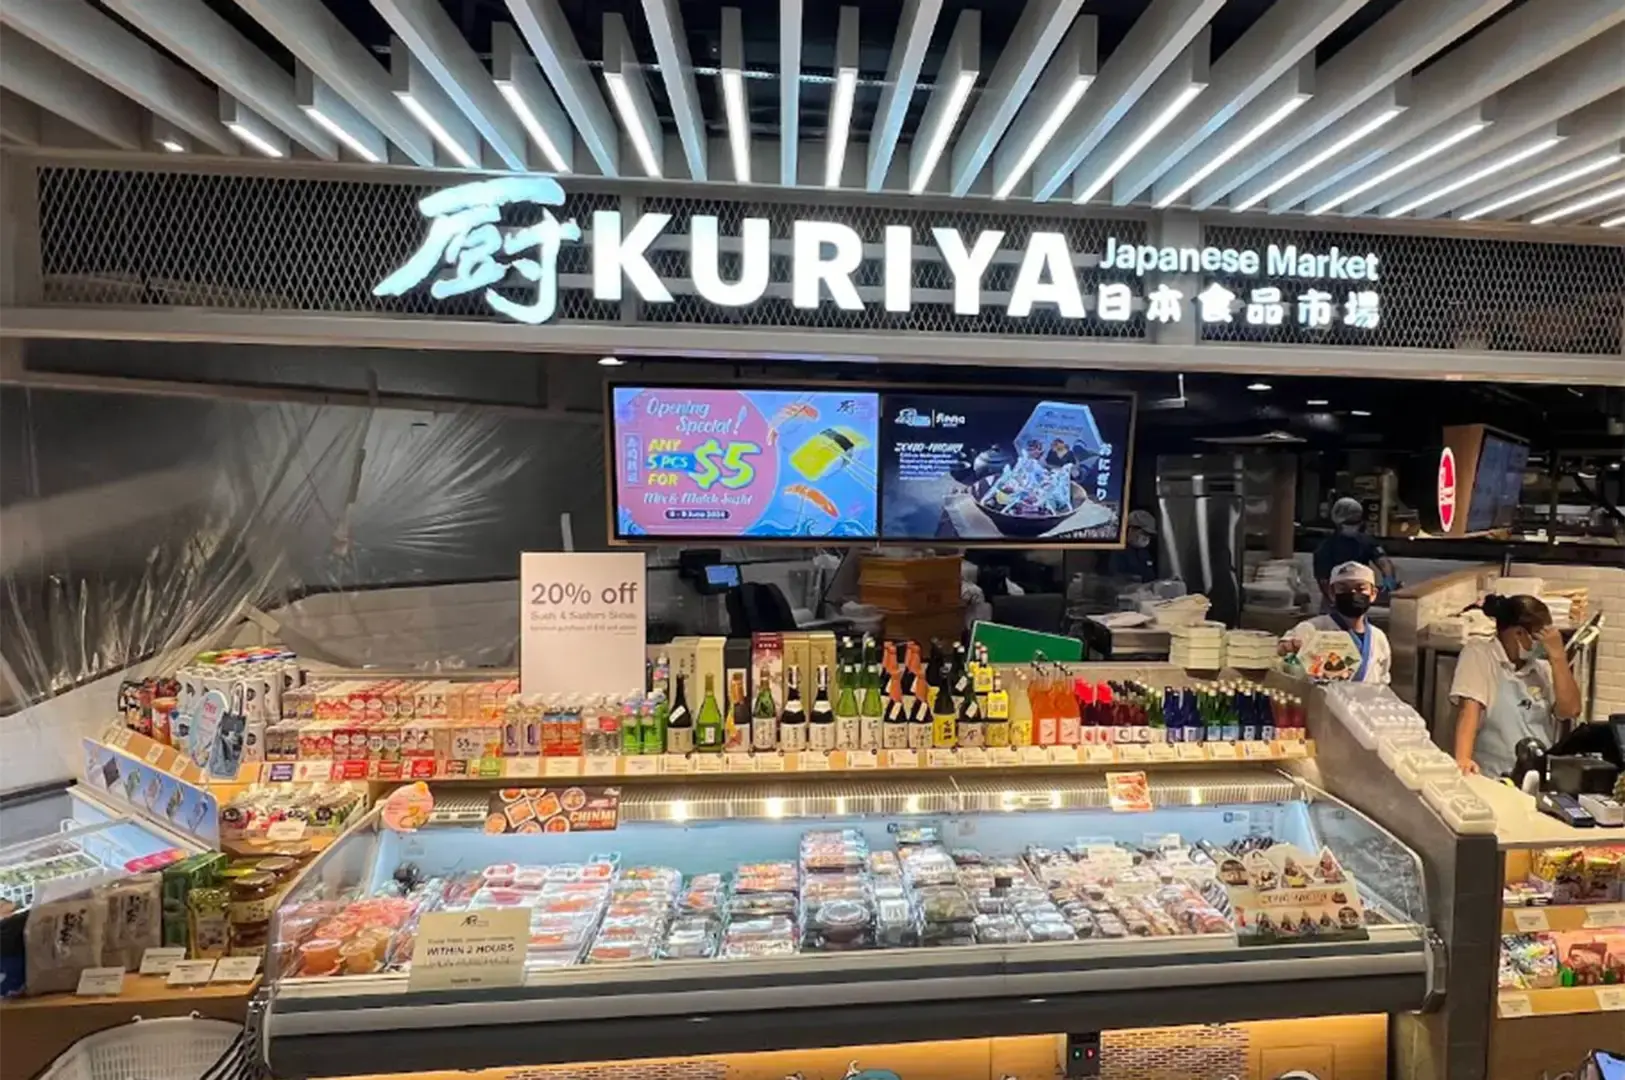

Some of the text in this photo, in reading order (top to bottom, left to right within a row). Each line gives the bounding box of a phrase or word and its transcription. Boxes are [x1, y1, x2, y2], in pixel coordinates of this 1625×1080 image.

[592, 209, 1086, 319] KURIYA
[1100, 237, 1379, 281] Japanese Market
[1097, 282, 1381, 330] 日本食品市場
[646, 397, 711, 419] Opening
[648, 438, 682, 452] ANY
[661, 455, 688, 469] PCS
[689, 439, 761, 490] $5
[648, 472, 679, 487] FOR
[643, 492, 668, 506] Mix
[681, 492, 719, 506] Match
[530, 582, 638, 605] 20% off
[569, 809, 617, 824] CHINMI
[426, 946, 465, 957] WITHIN
[475, 943, 516, 955] HOURS
